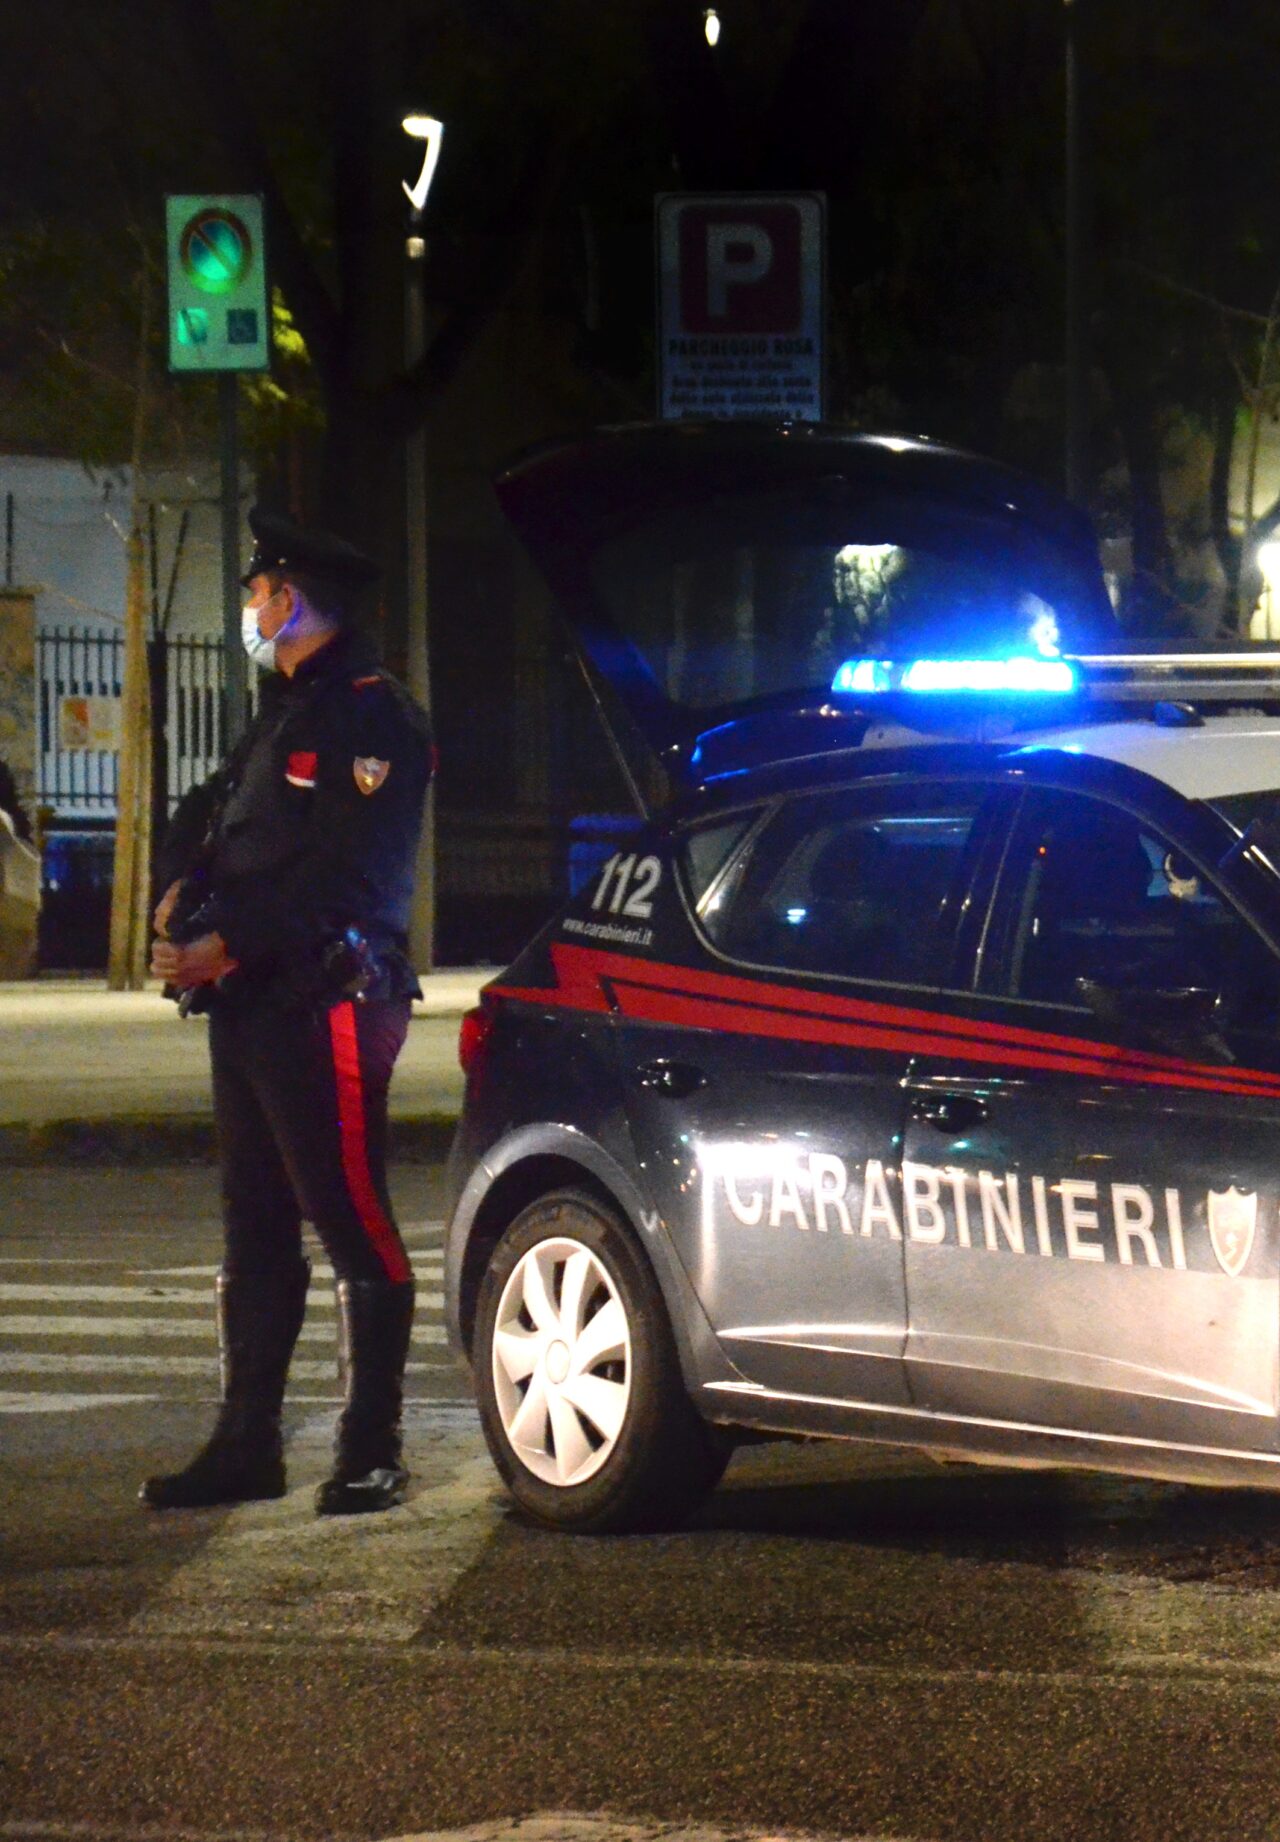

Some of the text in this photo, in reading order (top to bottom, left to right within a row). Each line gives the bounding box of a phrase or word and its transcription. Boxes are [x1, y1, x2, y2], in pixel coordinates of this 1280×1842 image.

[706, 222, 773, 317] P
[669, 337, 813, 355] PARCHEGGIO ROSA
[591, 852, 662, 918] 112
[723, 1146, 1187, 1269] CARABINIERI
